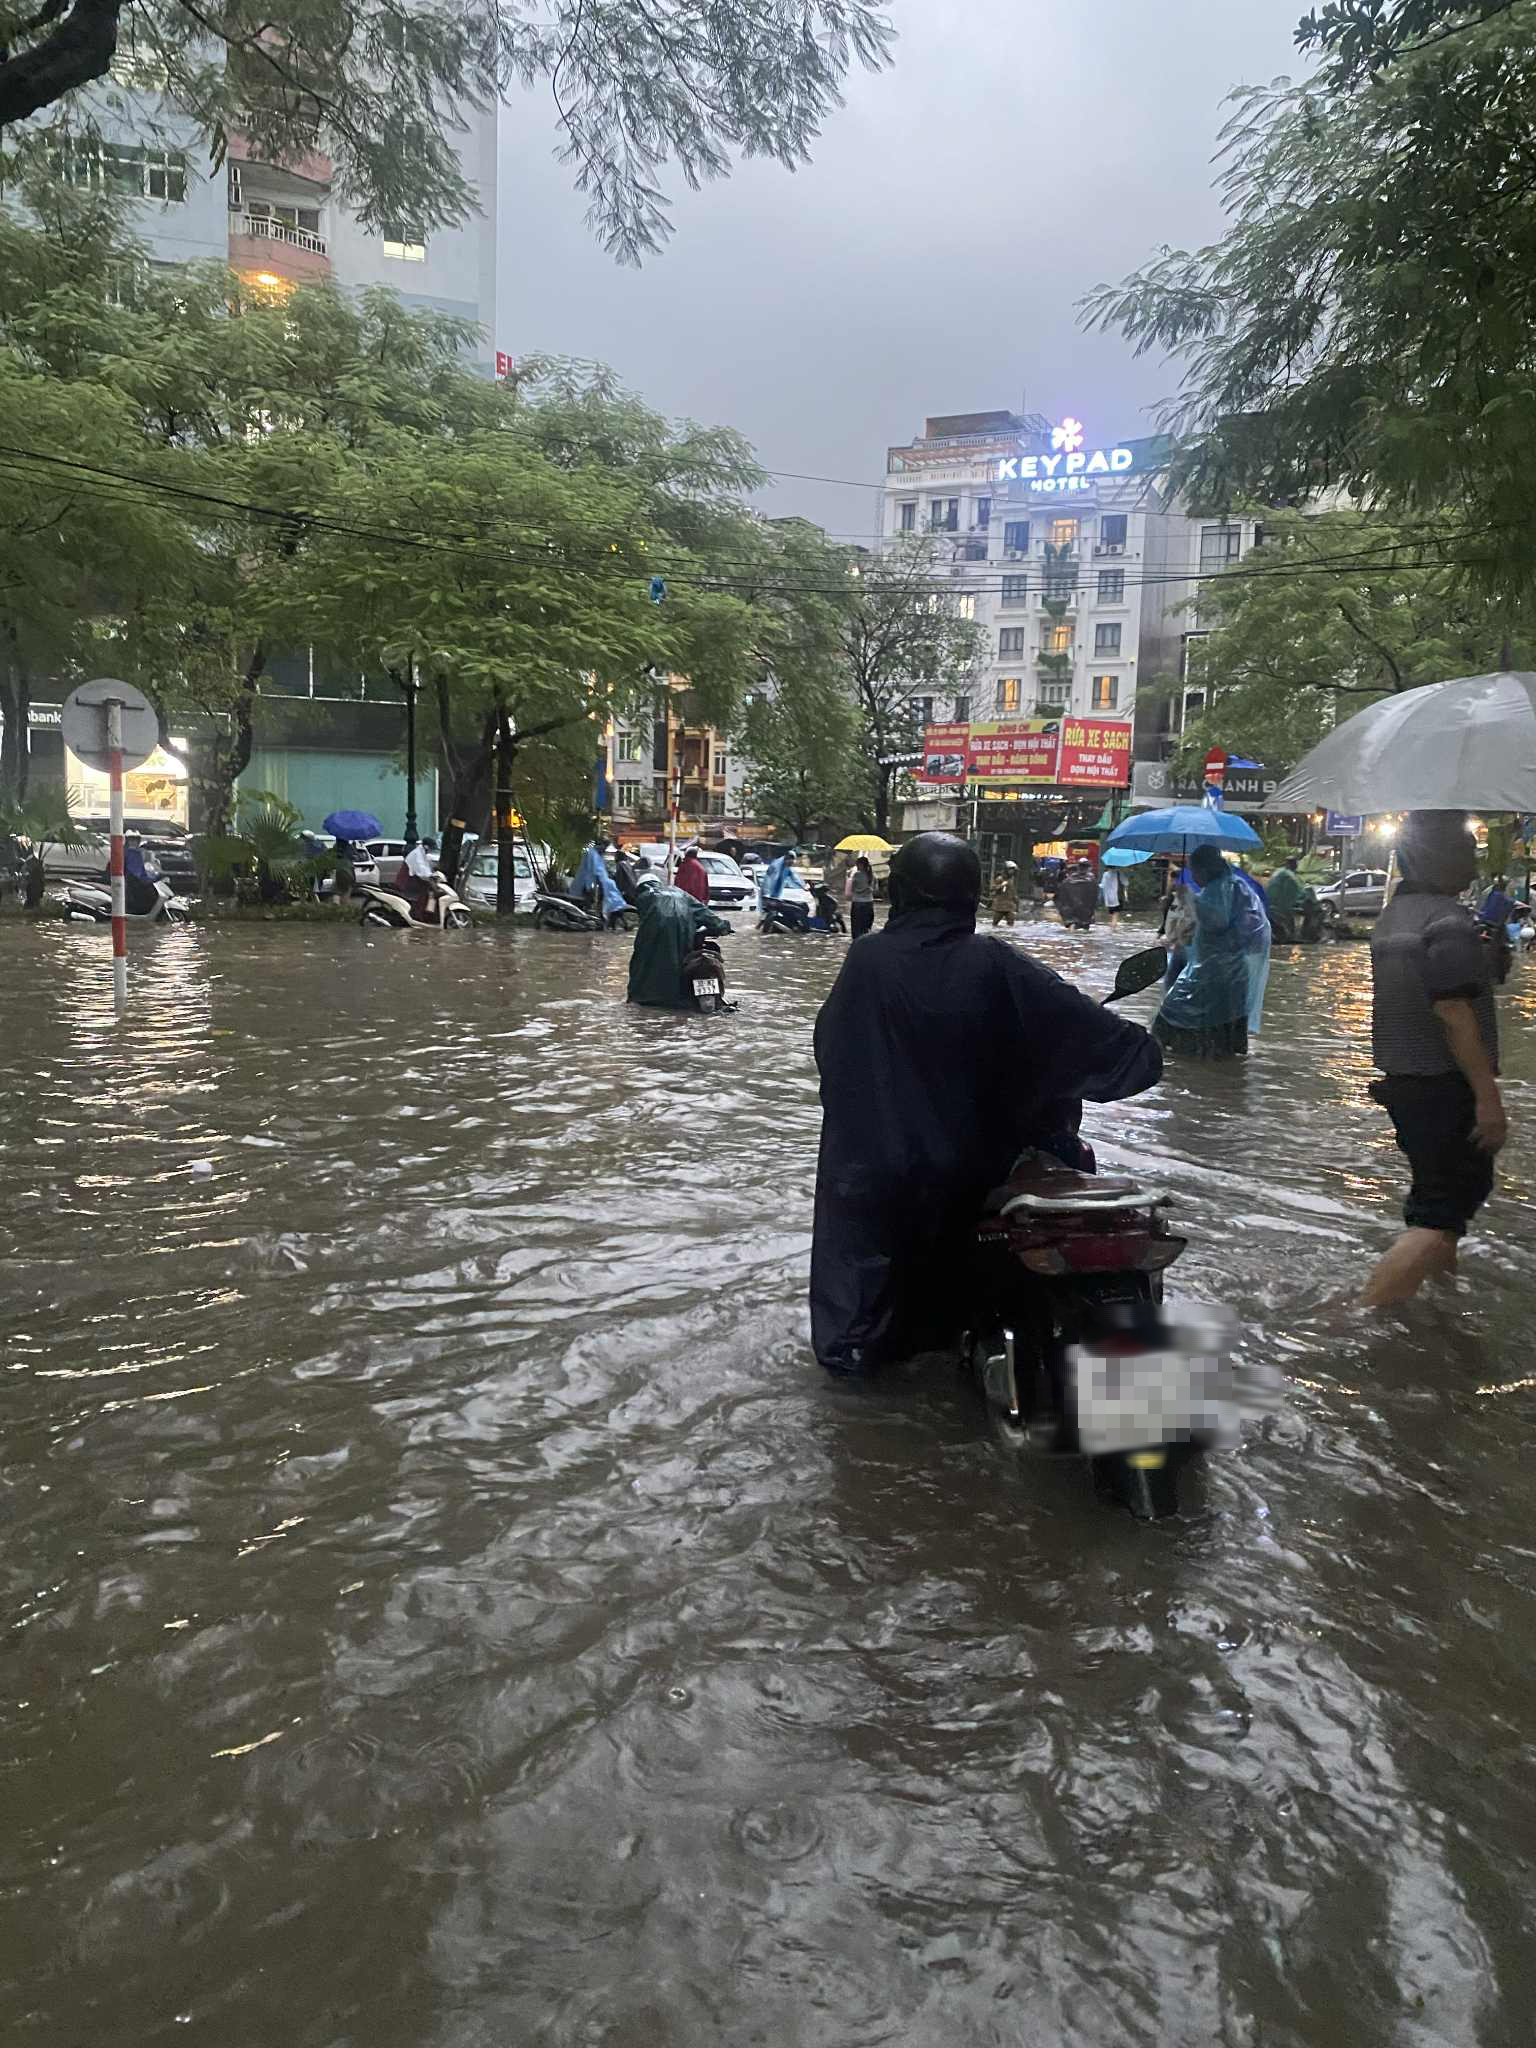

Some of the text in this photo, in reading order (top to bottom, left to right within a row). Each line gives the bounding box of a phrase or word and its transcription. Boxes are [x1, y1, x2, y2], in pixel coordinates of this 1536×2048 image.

[1030, 477, 1090, 491] HOTEL
[1087, 729, 1101, 748] XE
[1103, 730, 1129, 752] SẠCH
[1078, 754, 1097, 763] THAY
